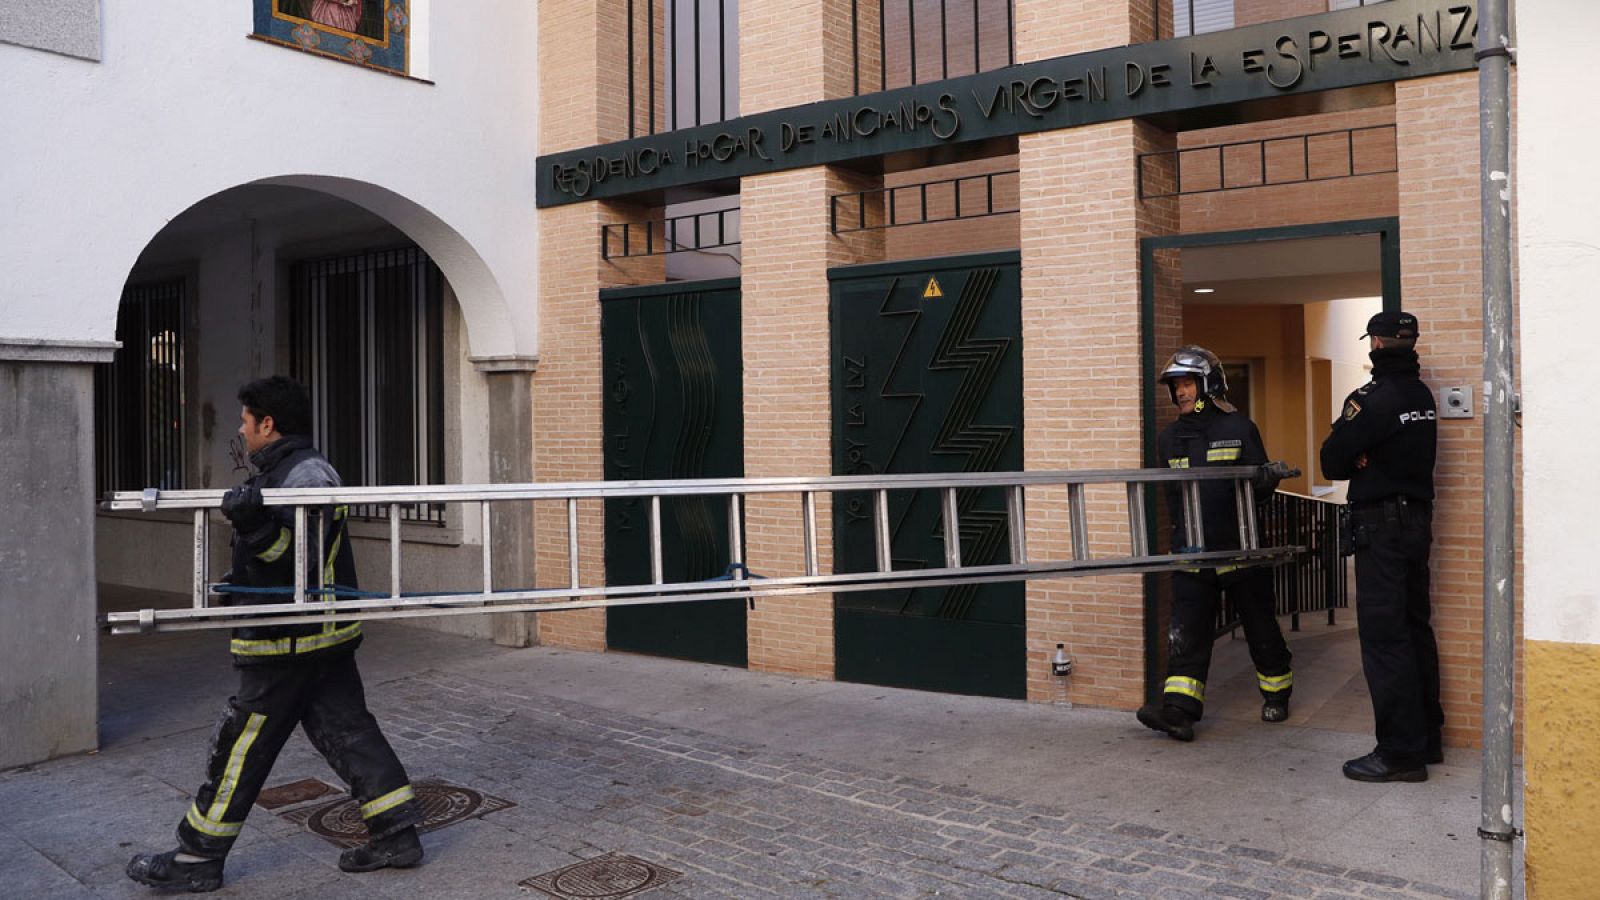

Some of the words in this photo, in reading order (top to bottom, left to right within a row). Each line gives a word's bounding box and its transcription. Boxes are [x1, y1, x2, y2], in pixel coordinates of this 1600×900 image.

[551, 147, 673, 196] RESIDENCIA
[684, 127, 773, 162] HOGAR
[780, 122, 816, 152] DE
[821, 93, 960, 144] ANCIANOS
[971, 64, 1108, 118] VIRGEN
[1125, 60, 1171, 97] DE
[1189, 50, 1222, 87] LA
[1242, 5, 1478, 89] ESPERANZ
[1399, 409, 1436, 425] POLIC
